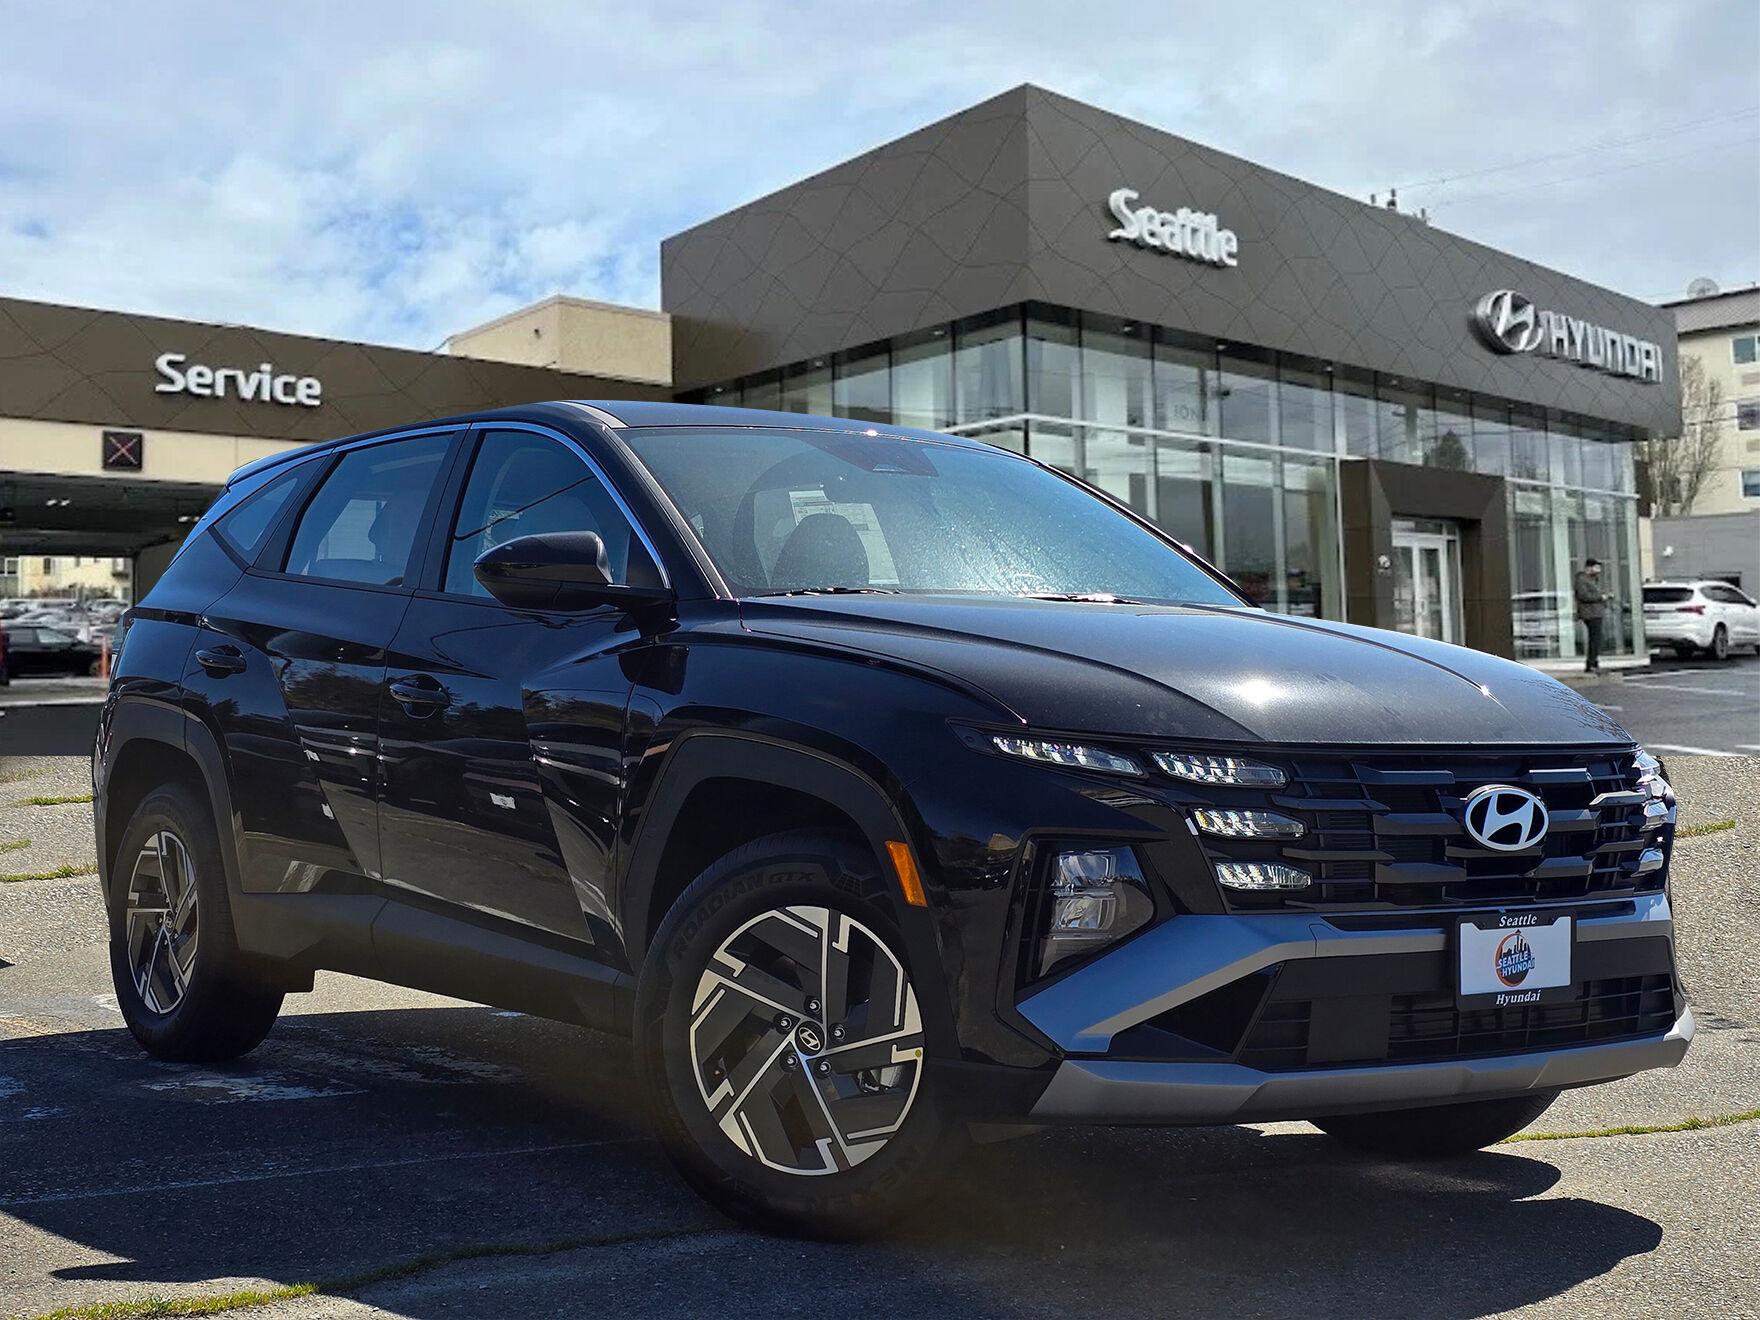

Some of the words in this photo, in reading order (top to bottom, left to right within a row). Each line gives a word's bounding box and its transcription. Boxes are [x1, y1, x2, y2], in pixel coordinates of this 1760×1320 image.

[1109, 188, 1238, 267] Seattle
[1543, 311, 1664, 383] HYUNDAI
[155, 353, 322, 407] Service
[674, 872, 765, 959] ROADIAN
[767, 871, 817, 885] GTX
[1499, 914, 1538, 927] Seattle
[1497, 951, 1530, 969] SEATTLE
[1502, 957, 1535, 977] HYUNDAI
[1495, 989, 1541, 1007] Hyundai
